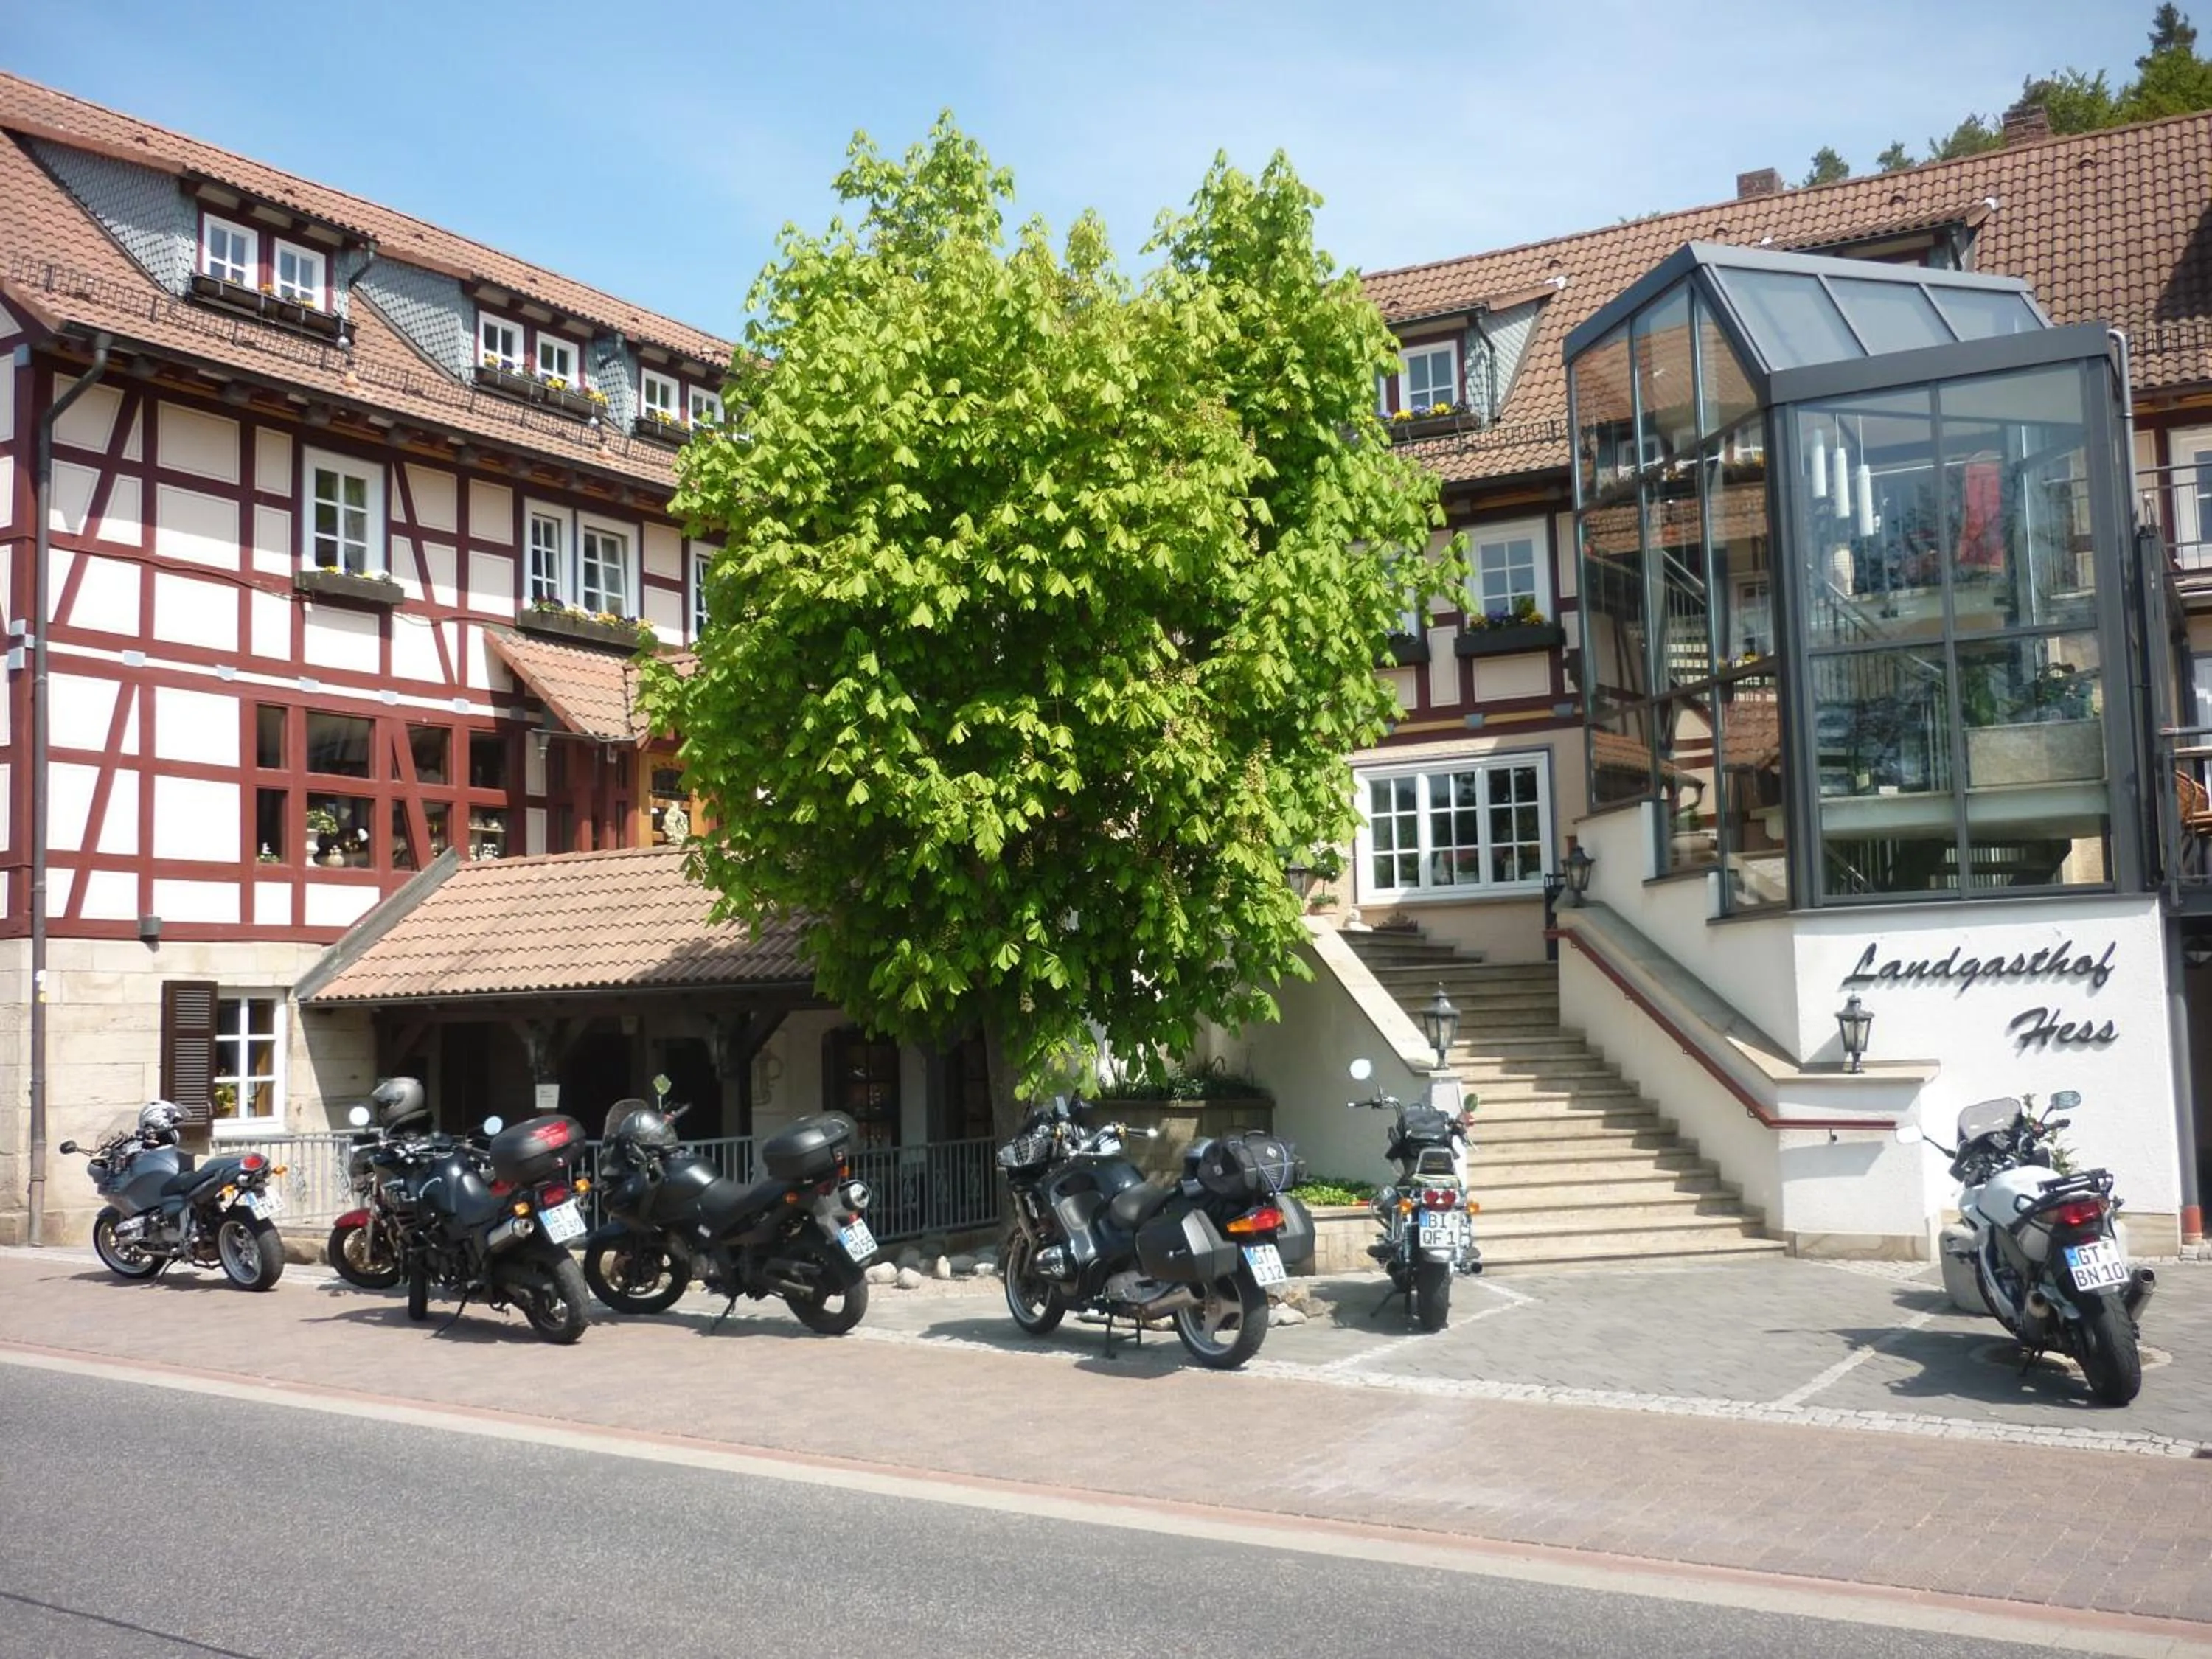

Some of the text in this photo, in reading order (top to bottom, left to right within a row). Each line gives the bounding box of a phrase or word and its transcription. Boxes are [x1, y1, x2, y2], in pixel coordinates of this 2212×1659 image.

[1842, 940, 2117, 991] Landgasthof
[2009, 1006, 2120, 1048] Hess
[1428, 1213, 1447, 1228] BI
[1422, 1229, 1456, 1245] QF 1
[1253, 1245, 1270, 1265] GT
[2077, 1245, 2100, 1265] GT
[1267, 1265, 1284, 1280] 12
[2075, 1262, 2126, 1287] BN 10
